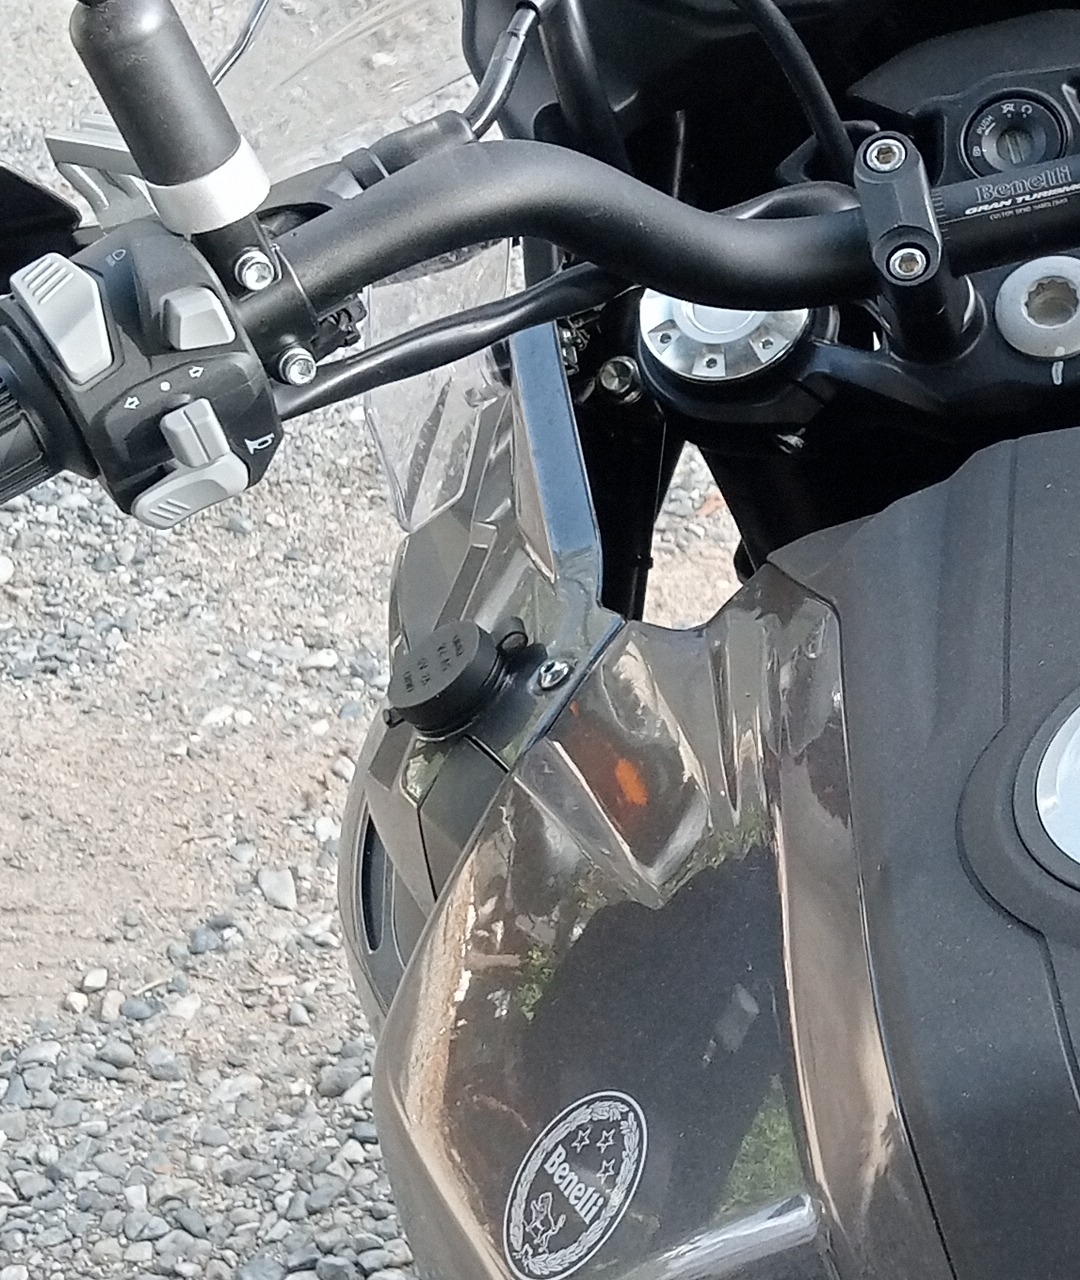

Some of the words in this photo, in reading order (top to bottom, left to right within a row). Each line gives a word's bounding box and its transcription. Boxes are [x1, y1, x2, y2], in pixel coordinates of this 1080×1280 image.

[976, 114, 996, 135] PUSH
[974, 165, 1073, 203] Benelli
[964, 198, 1012, 216] GRAN
[543, 1143, 605, 1225] Benelli
